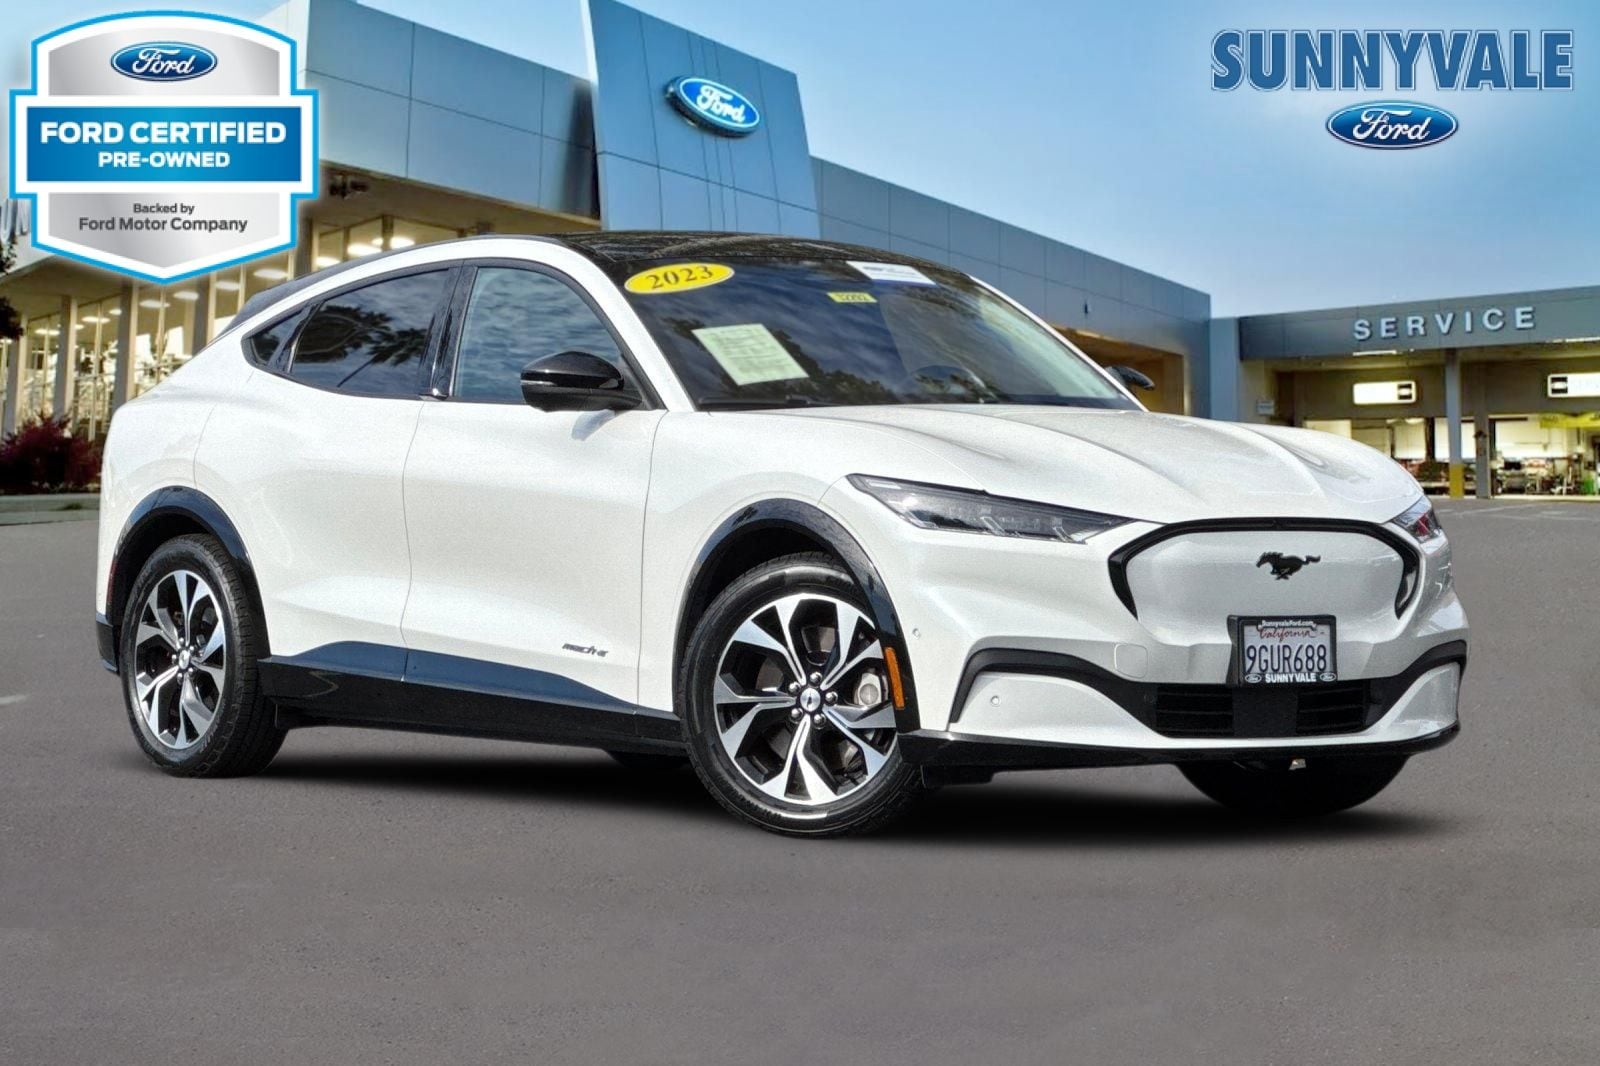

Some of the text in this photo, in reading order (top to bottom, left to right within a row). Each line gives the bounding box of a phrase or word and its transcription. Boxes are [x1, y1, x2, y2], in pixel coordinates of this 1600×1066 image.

[696, 84, 746, 123] Ford
[645, 265, 714, 290] 2023
[1353, 306, 1535, 341] SERVICE
[1246, 644, 1327, 673] 9GUR688
[1265, 672, 1317, 684] SUNNYVALE
